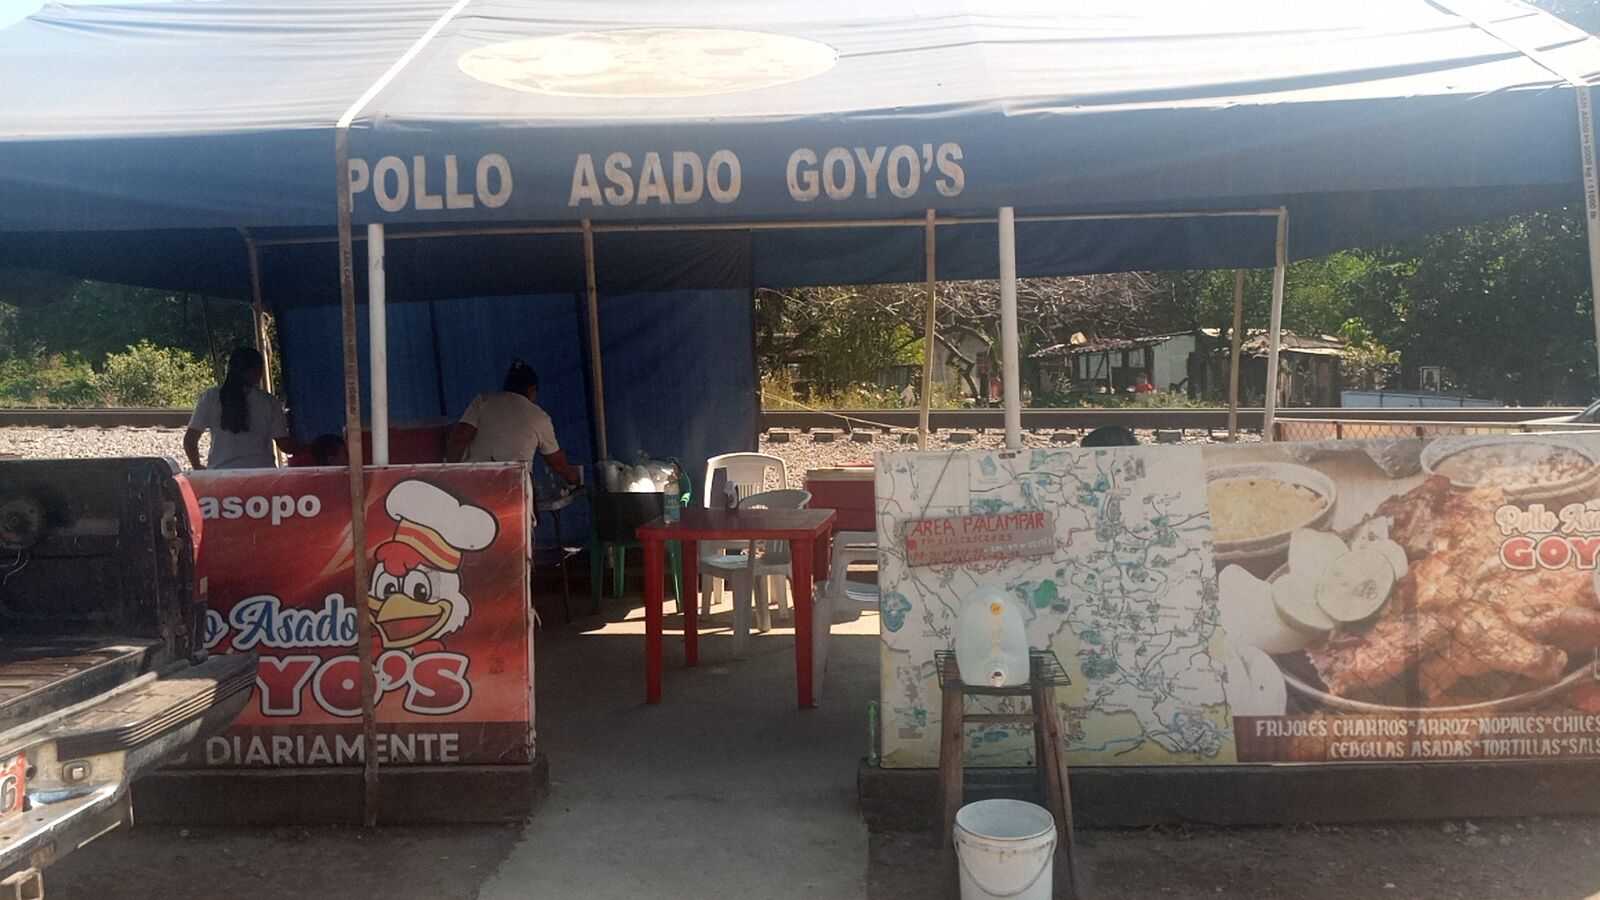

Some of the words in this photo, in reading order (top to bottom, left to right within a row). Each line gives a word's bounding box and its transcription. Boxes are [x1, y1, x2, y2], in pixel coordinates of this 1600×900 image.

[348, 153, 513, 213] POLLO
[568, 149, 742, 207] ASADO
[786, 142, 965, 202] GOYO'S
[911, 519, 955, 537] AREA
[1495, 504, 1559, 536] Pollo
[230, 594, 359, 649] Asado
[1256, 720, 1327, 737] FRIJOLES
[206, 733, 459, 765] DIARIAMENTE
